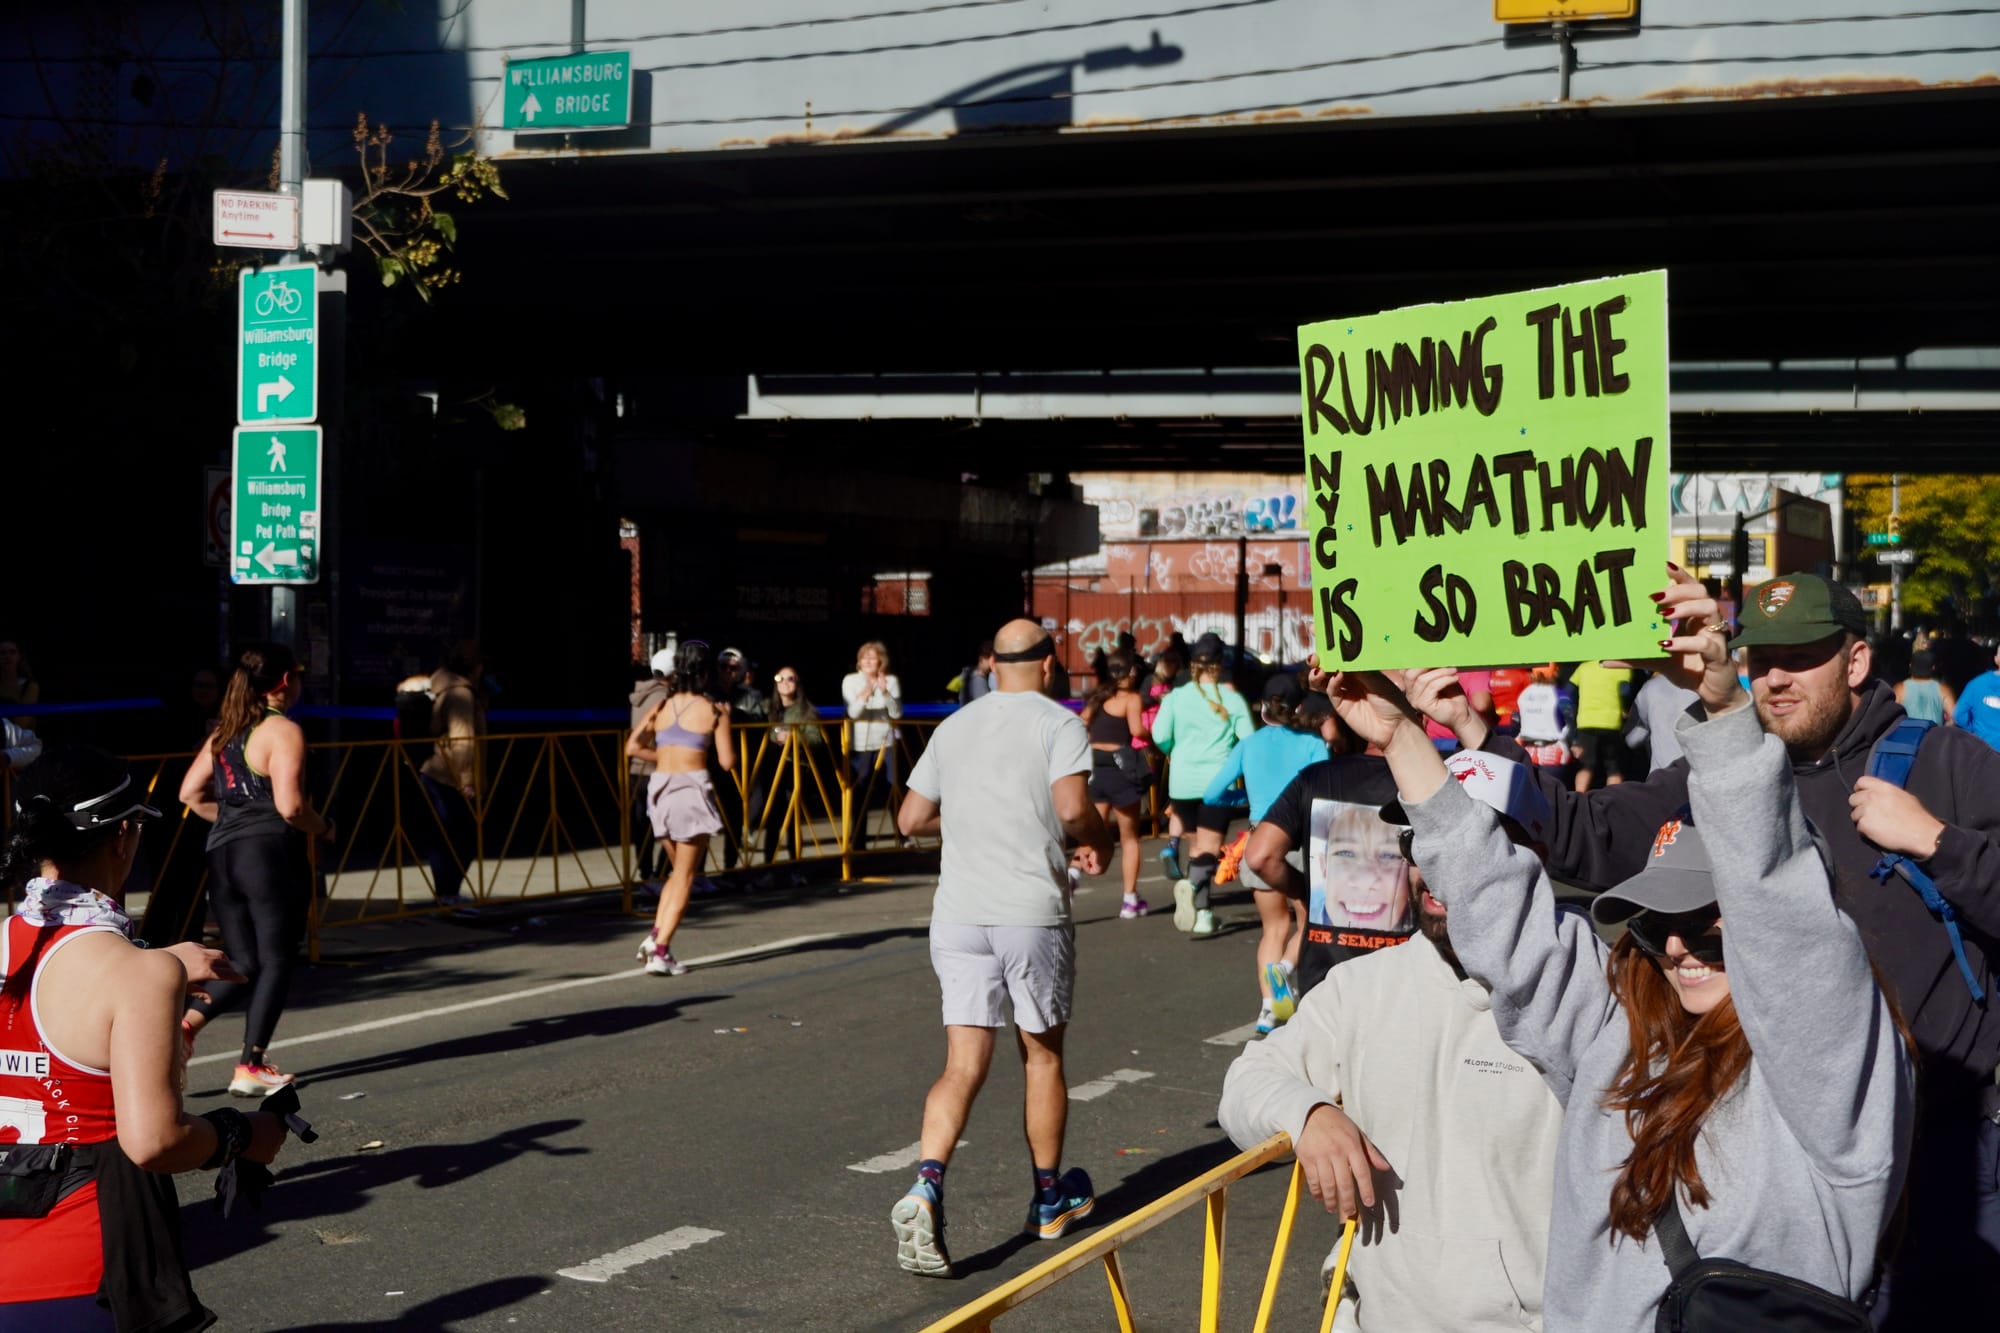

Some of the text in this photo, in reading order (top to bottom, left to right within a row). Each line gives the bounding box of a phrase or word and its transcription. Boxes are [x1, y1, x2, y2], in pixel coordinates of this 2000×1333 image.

[511, 62, 623, 86] WILLIAMSBURG
[555, 93, 611, 114] BRIDGE
[221, 199, 278, 212] NO PARKING
[222, 210, 260, 222] Anytime
[244, 326, 314, 344] Williamsburg
[258, 351, 297, 370] Bridge
[1304, 294, 1631, 435] RUNNING THE
[247, 481, 306, 499] Williamsburg
[1364, 437, 1654, 547] MARATHON
[261, 502, 291, 521] Bridge
[1309, 450, 1343, 570] NYC
[256, 524, 296, 539] Ped Path
[1320, 578, 1364, 662] IS
[1413, 564, 1477, 642] SO
[1503, 548, 1636, 638] BRAT
[1308, 929, 1333, 944] PER
[0, 1053, 48, 1074] WIE
[1464, 1058, 1493, 1067] PELOTON
[1495, 1062, 1524, 1073] STUDIOS
